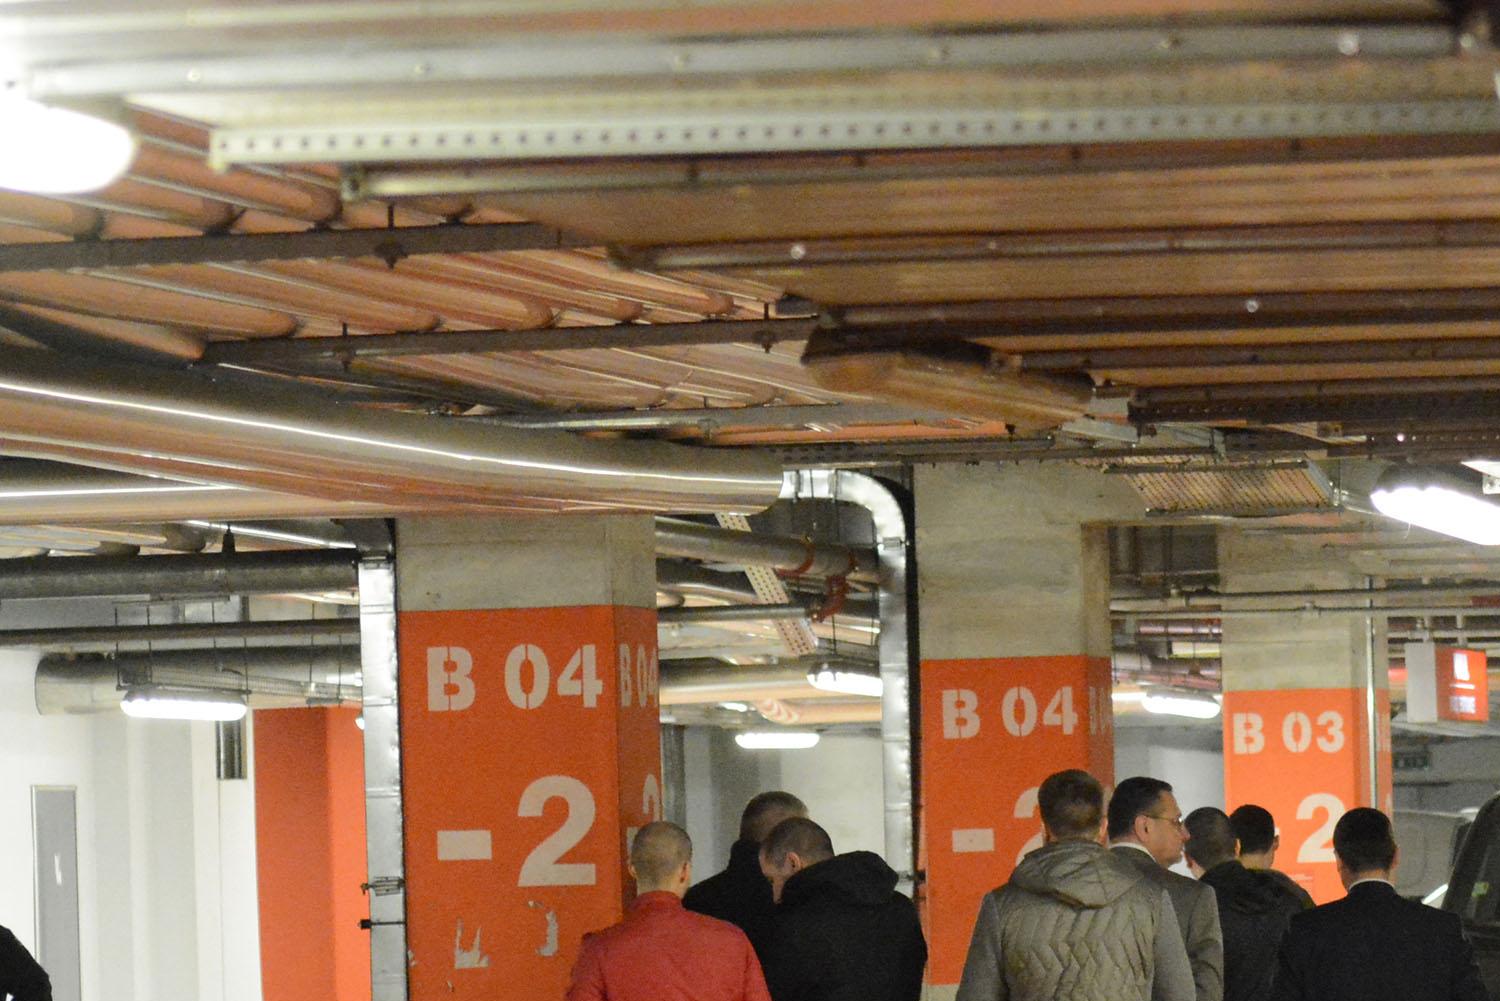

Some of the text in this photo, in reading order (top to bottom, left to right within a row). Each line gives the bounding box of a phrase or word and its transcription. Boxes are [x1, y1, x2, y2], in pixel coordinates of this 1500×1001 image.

[426, 643, 603, 712] B 04
[942, 688, 981, 739] B
[1001, 686, 1079, 737] 04
[1233, 712, 1265, 755] B
[1282, 710, 1345, 753] 03
[437, 775, 597, 887] -2
